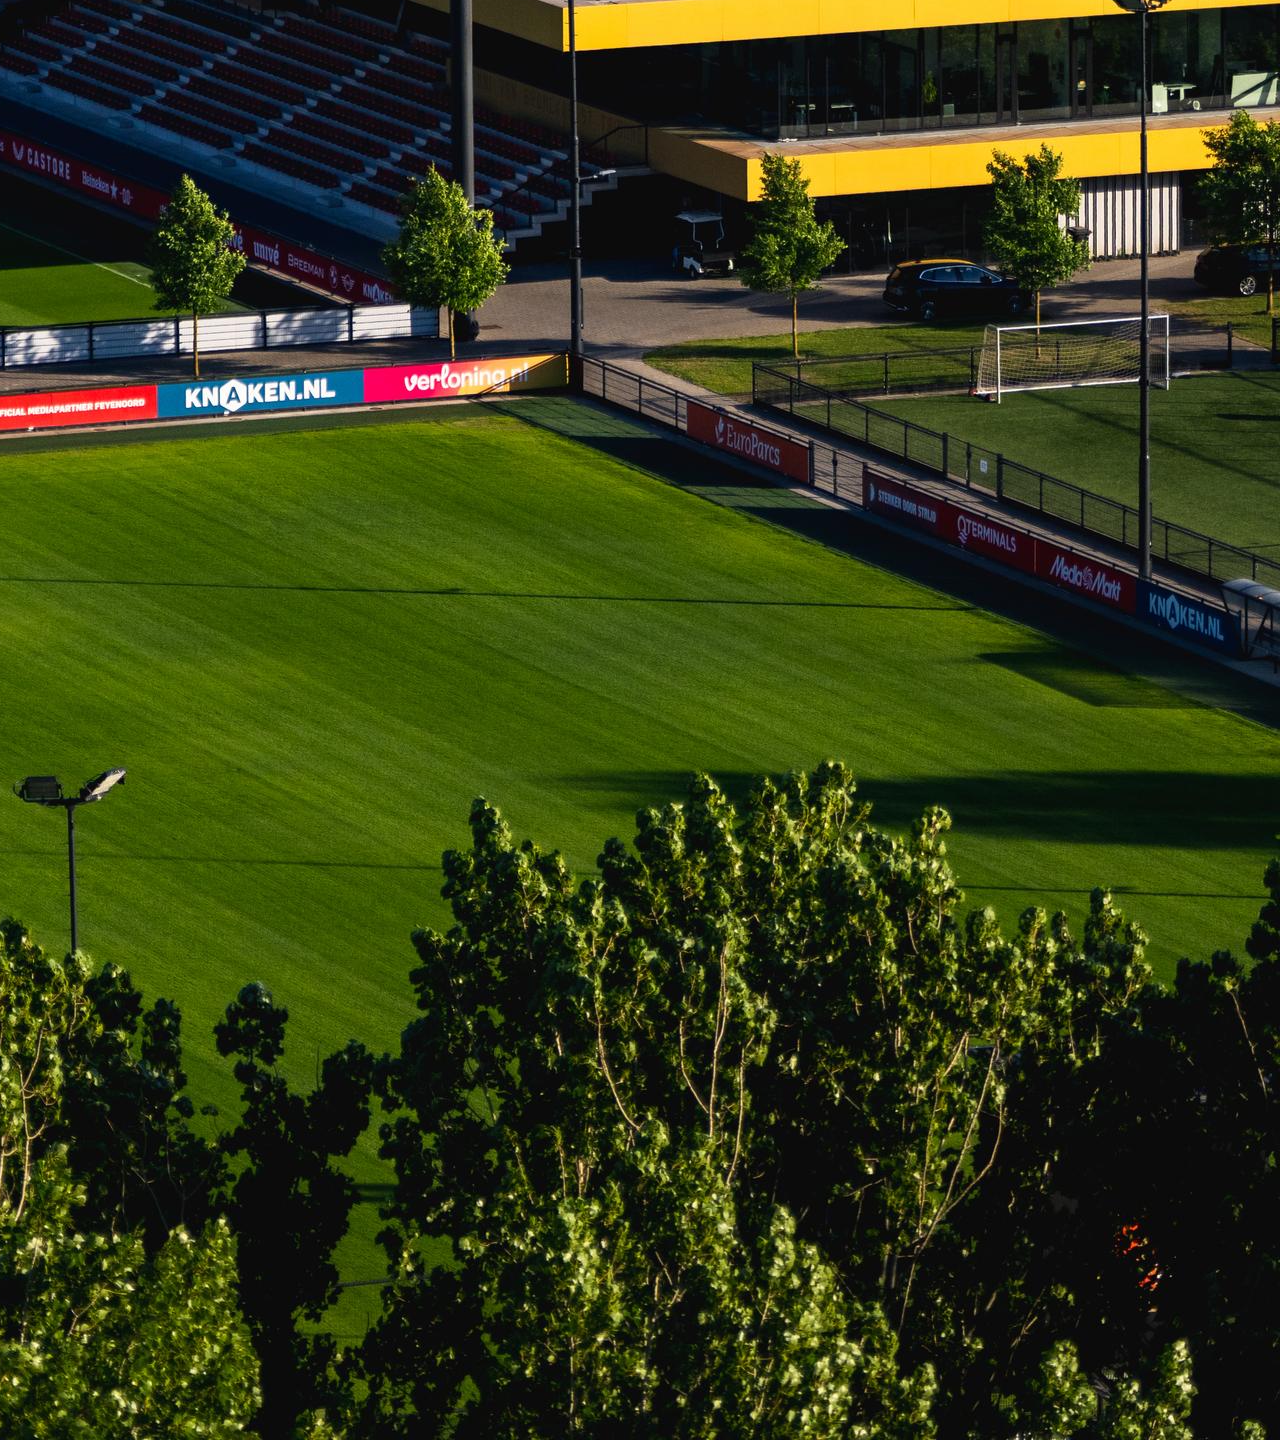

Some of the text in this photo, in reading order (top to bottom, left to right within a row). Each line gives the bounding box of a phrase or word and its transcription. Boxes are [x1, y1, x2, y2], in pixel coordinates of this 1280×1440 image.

[27, 147, 70, 180] CASTORE
[81, 170, 110, 194] Heineken
[253, 244, 280, 266] univé
[287, 253, 324, 279] BREEMAN
[28, 402, 93, 416] MEDIAPARTNER
[94, 398, 145, 411] FEYENOORD
[185, 378, 336, 412] KNAKEN.NL
[726, 422, 780, 466] EuroParcs
[957, 515, 1017, 552] QTERMINALS
[1149, 592, 1224, 641] KNAKEN.NL
